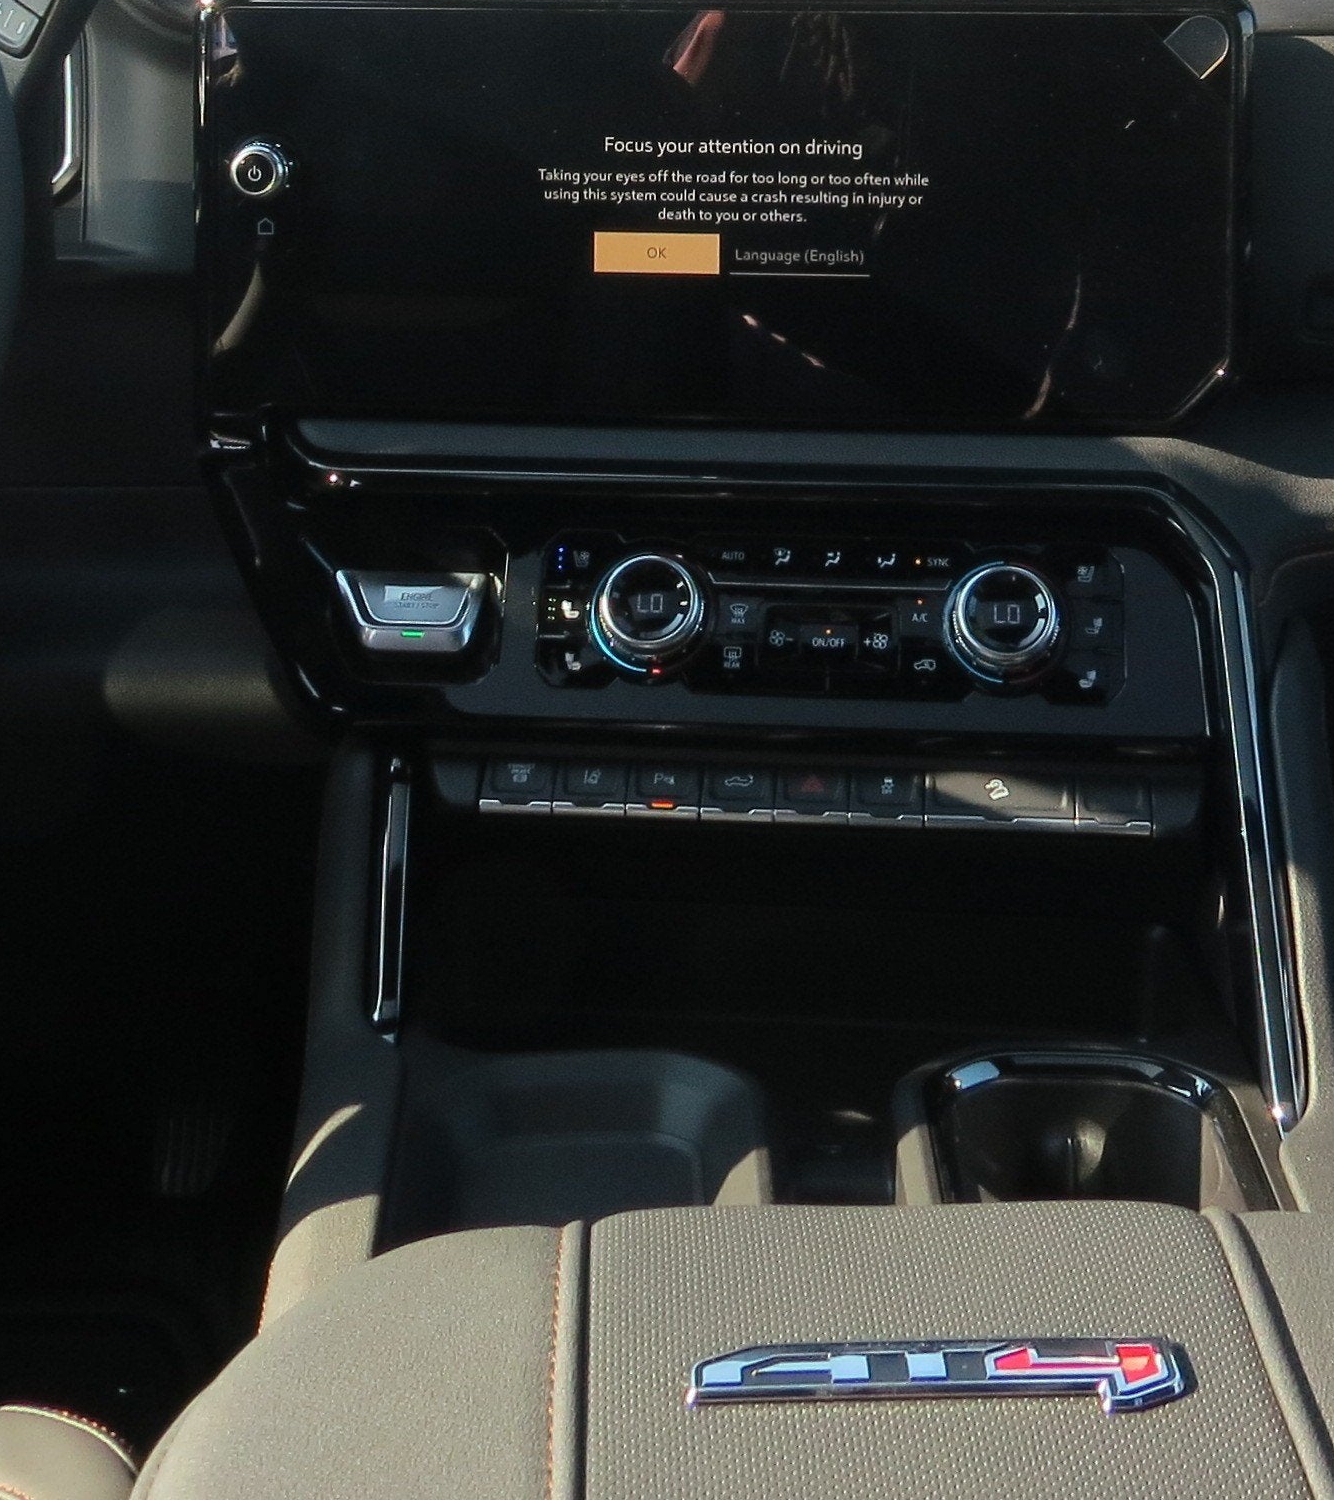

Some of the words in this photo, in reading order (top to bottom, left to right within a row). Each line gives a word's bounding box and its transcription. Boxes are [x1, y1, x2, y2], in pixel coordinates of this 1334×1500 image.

[604, 136, 653, 153] Focus
[657, 140, 695, 158] your
[698, 138, 775, 156] attention
[779, 142, 801, 156] on
[805, 139, 864, 160] driving
[538, 169, 580, 185] Taking
[583, 173, 613, 186] your
[615, 173, 646, 186] eyes
[648, 170, 669, 184] off
[671, 171, 693, 184] the
[696, 171, 726, 185] road
[729, 171, 749, 185] for
[752, 172, 775, 186] too
[777, 171, 808, 188] long
[811, 175, 826, 186] or
[828, 173, 851, 187] too
[854, 172, 891, 188] often
[894, 173, 929, 187] while
[544, 189, 579, 204] using
[583, 188, 607, 202] this
[610, 190, 657, 205] system
[660, 189, 696, 203] could
[699, 192, 738, 204] cause
[740, 193, 749, 204] a
[751, 190, 787, 204] crash
[790, 190, 849, 207] resulting
[852, 191, 865, 205] in
[867, 191, 906, 209] injury
[908, 195, 923, 206] or
[658, 208, 696, 222] death
[699, 210, 713, 222] to
[716, 212, 739, 226] you
[742, 213, 757, 223] or
[760, 209, 807, 223] others.
[646, 246, 667, 260] OK
[735, 249, 801, 267] Language
[804, 248, 865, 266] (English)
[721, 551, 746, 561] AUTO
[926, 557, 952, 568] SYNC
[911, 612, 928, 624] A/C
[811, 636, 846, 649] ON/OFF
